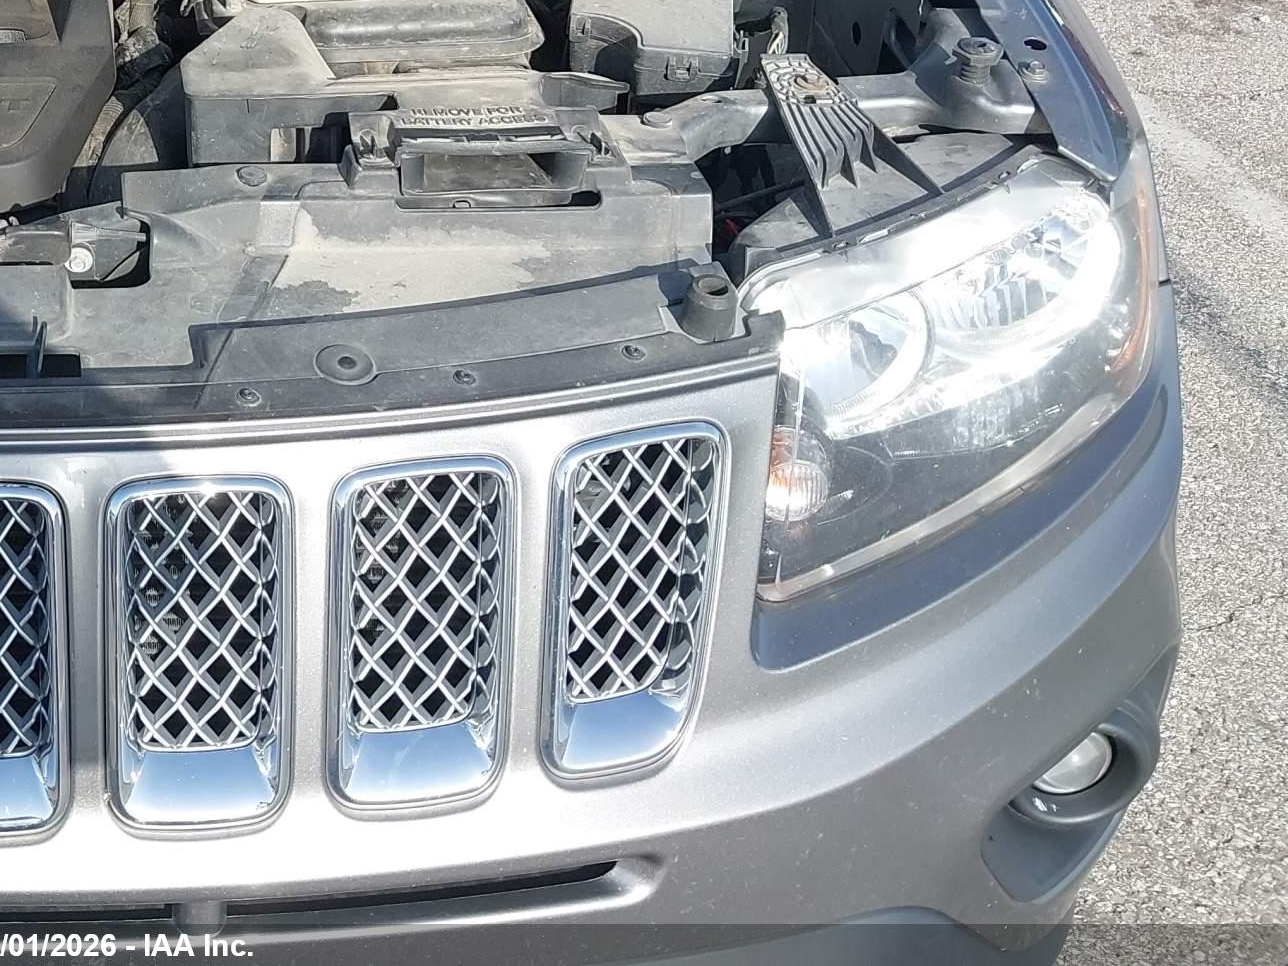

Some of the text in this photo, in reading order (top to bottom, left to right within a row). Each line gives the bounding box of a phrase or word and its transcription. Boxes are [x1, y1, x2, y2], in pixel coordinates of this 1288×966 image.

[411, 105, 523, 116] REMOVE FOR
[401, 114, 548, 126] BATTERY ACCESS
